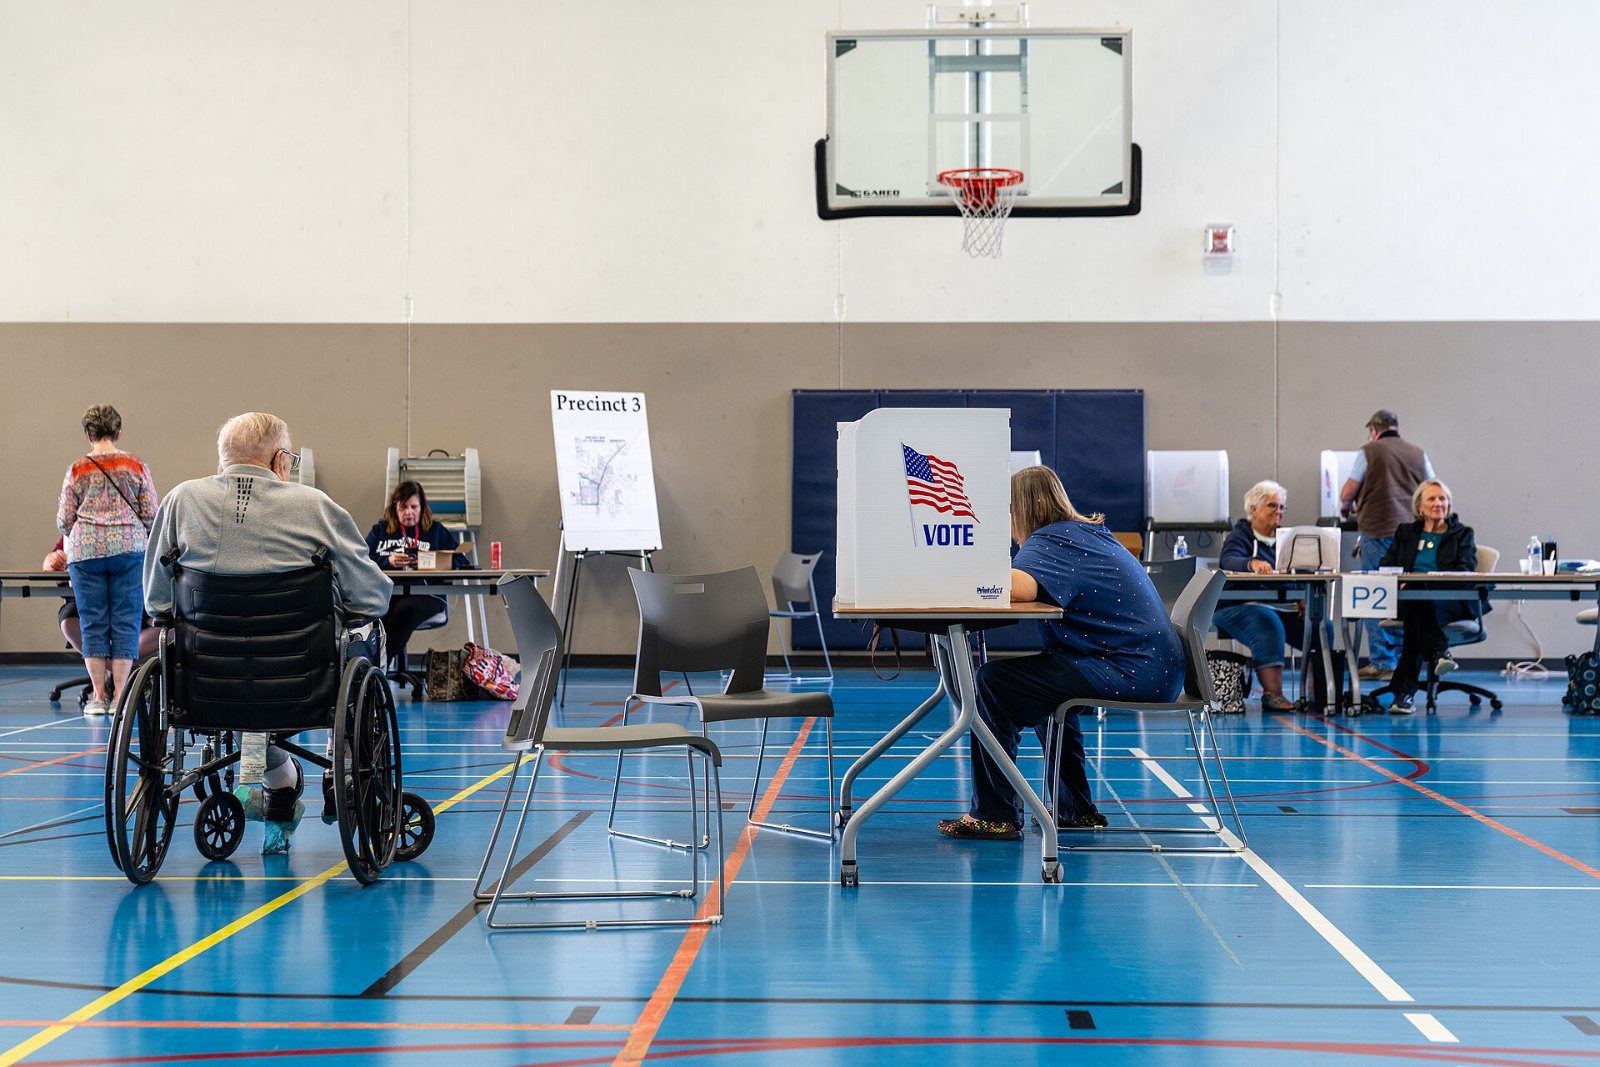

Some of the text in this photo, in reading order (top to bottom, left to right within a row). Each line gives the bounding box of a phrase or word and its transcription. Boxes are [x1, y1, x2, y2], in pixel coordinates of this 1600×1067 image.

[556, 394, 641, 412] Precinct 3
[923, 524, 974, 546] VOTE
[1352, 586, 1387, 610] P2
